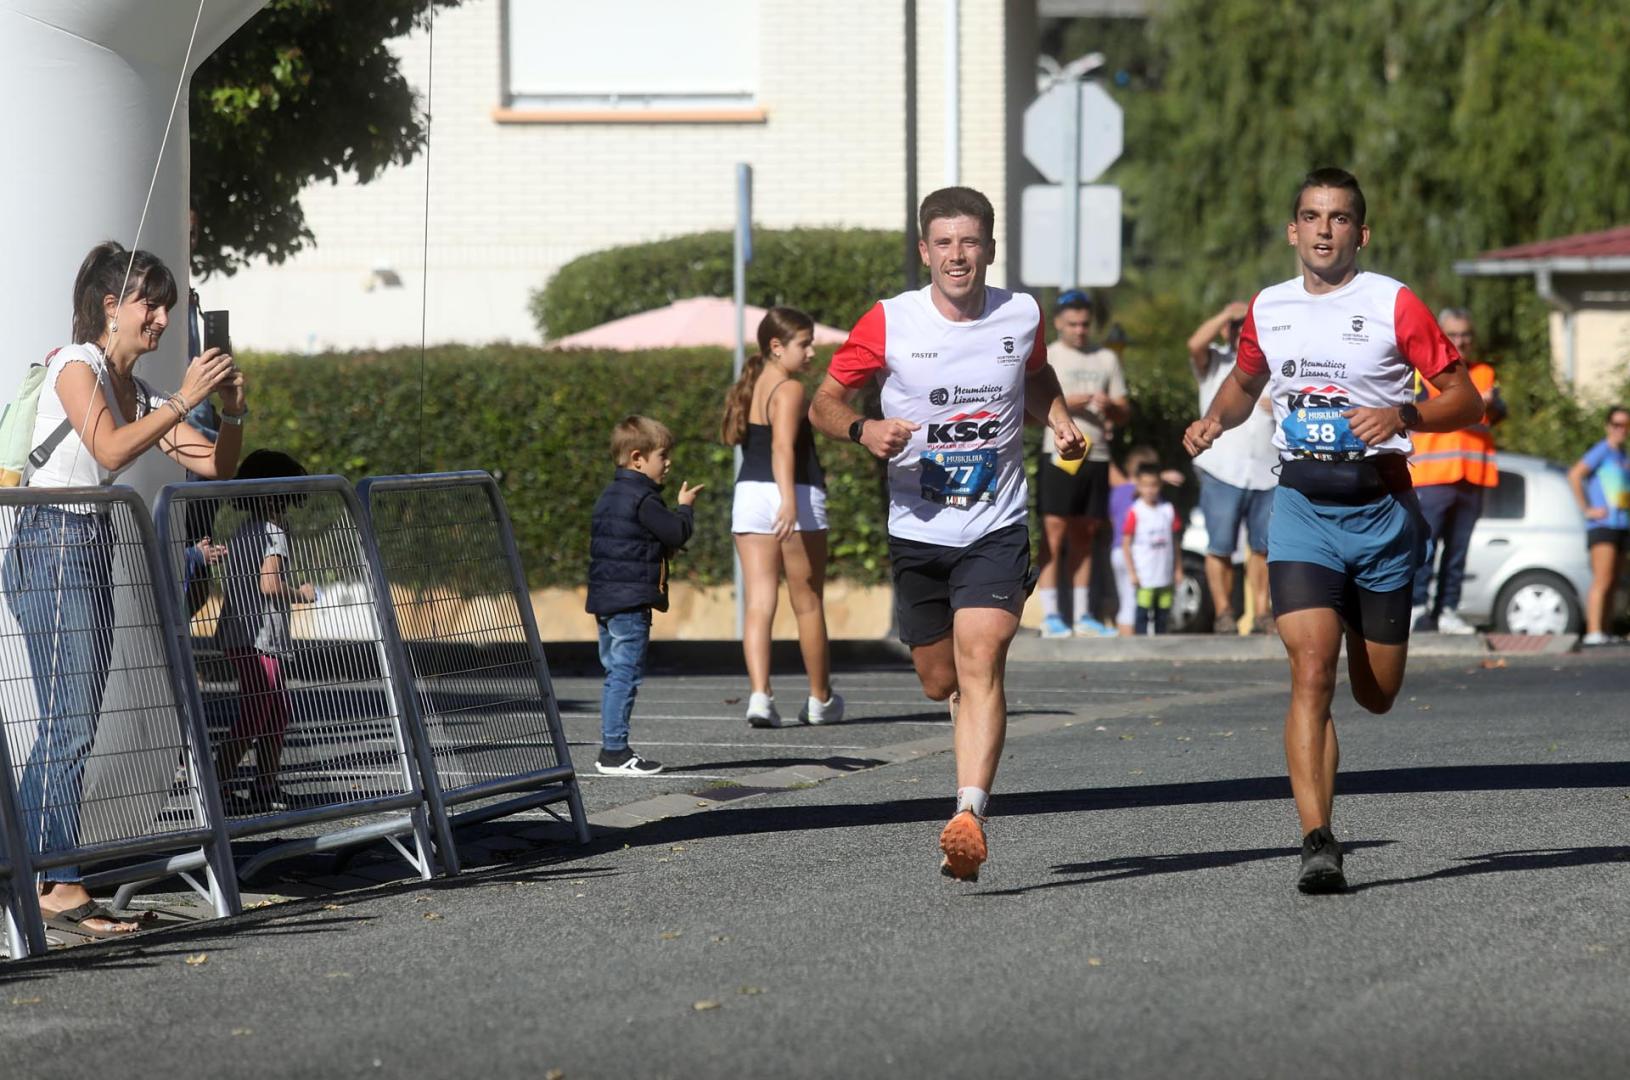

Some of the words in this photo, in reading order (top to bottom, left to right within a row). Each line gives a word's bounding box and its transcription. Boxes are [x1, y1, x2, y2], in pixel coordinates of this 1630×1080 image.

[1300, 358, 1346, 369] Neumáticos
[953, 384, 1003, 396] Neumáticos
[927, 420, 1001, 444] KSC
[1305, 423, 1336, 443] 38
[944, 465, 974, 485] 77
